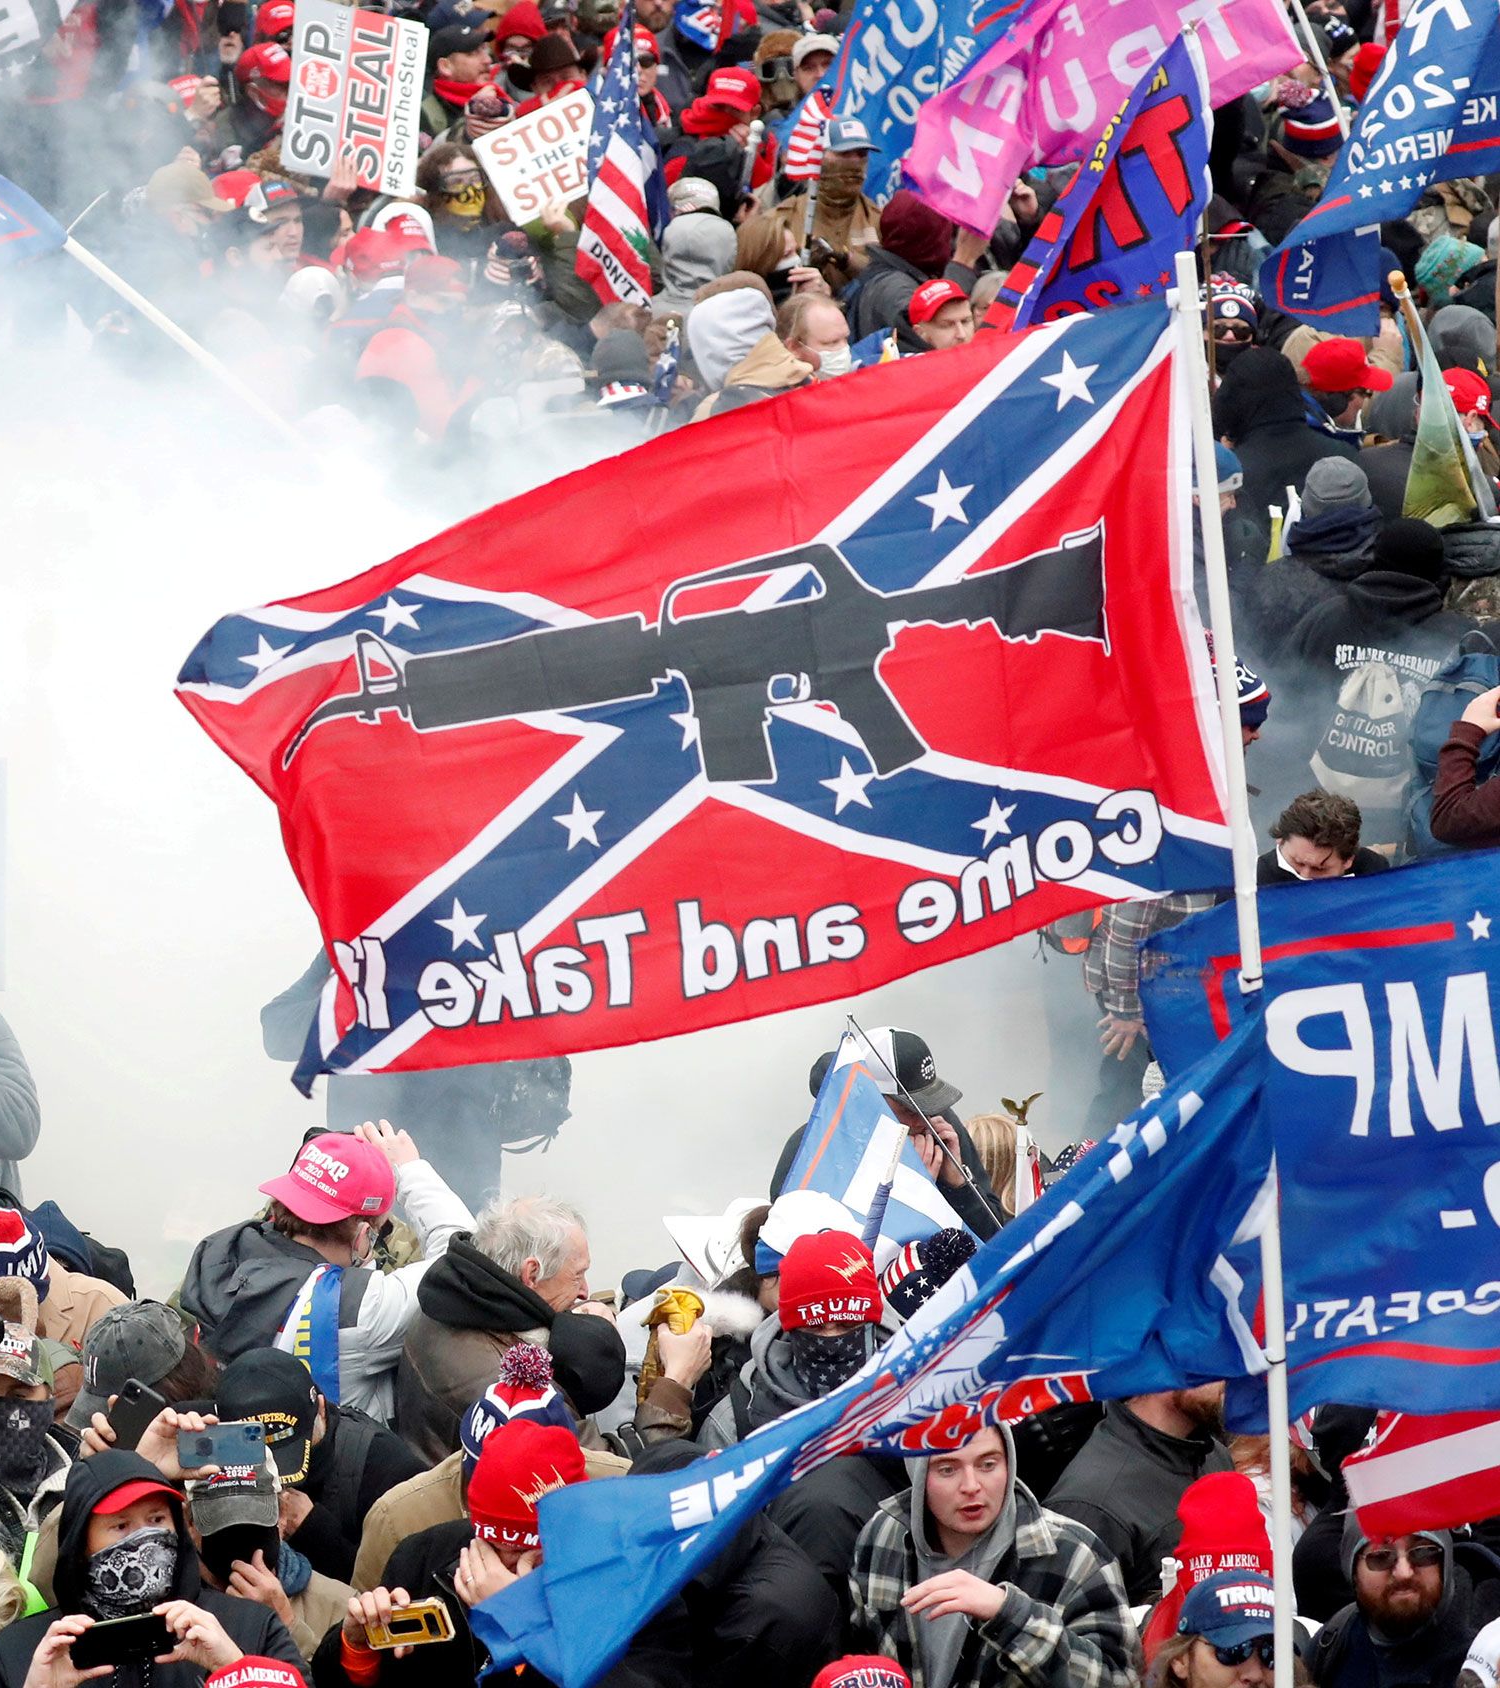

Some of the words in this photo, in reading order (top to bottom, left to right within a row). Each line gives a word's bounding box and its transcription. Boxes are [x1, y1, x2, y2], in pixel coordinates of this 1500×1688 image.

[290, 22, 342, 168] STOP
[344, 24, 394, 180] STEAL
[387, 28, 419, 190] #StopTheSteal
[490, 102, 587, 166] STOP
[531, 142, 575, 170] THE
[513, 155, 589, 211] STEA
[590, 242, 639, 298] DON'T
[299, 1143, 350, 1183] TRUMP
[304, 1162, 324, 1179] 2020
[797, 1297, 872, 1320] TRUMP
[828, 1312, 866, 1322] PRESIDENT
[257, 1412, 299, 1427] VETERAN
[474, 1522, 540, 1547] TRUM
[1189, 1554, 1213, 1571] MAKE
[1219, 1553, 1260, 1568] AMERICA
[1215, 1585, 1275, 1608] TRUM
[1244, 1608, 1271, 1619] 2020
[208, 1670, 239, 1688] MAKE
[239, 1665, 298, 1687] AMERICA
